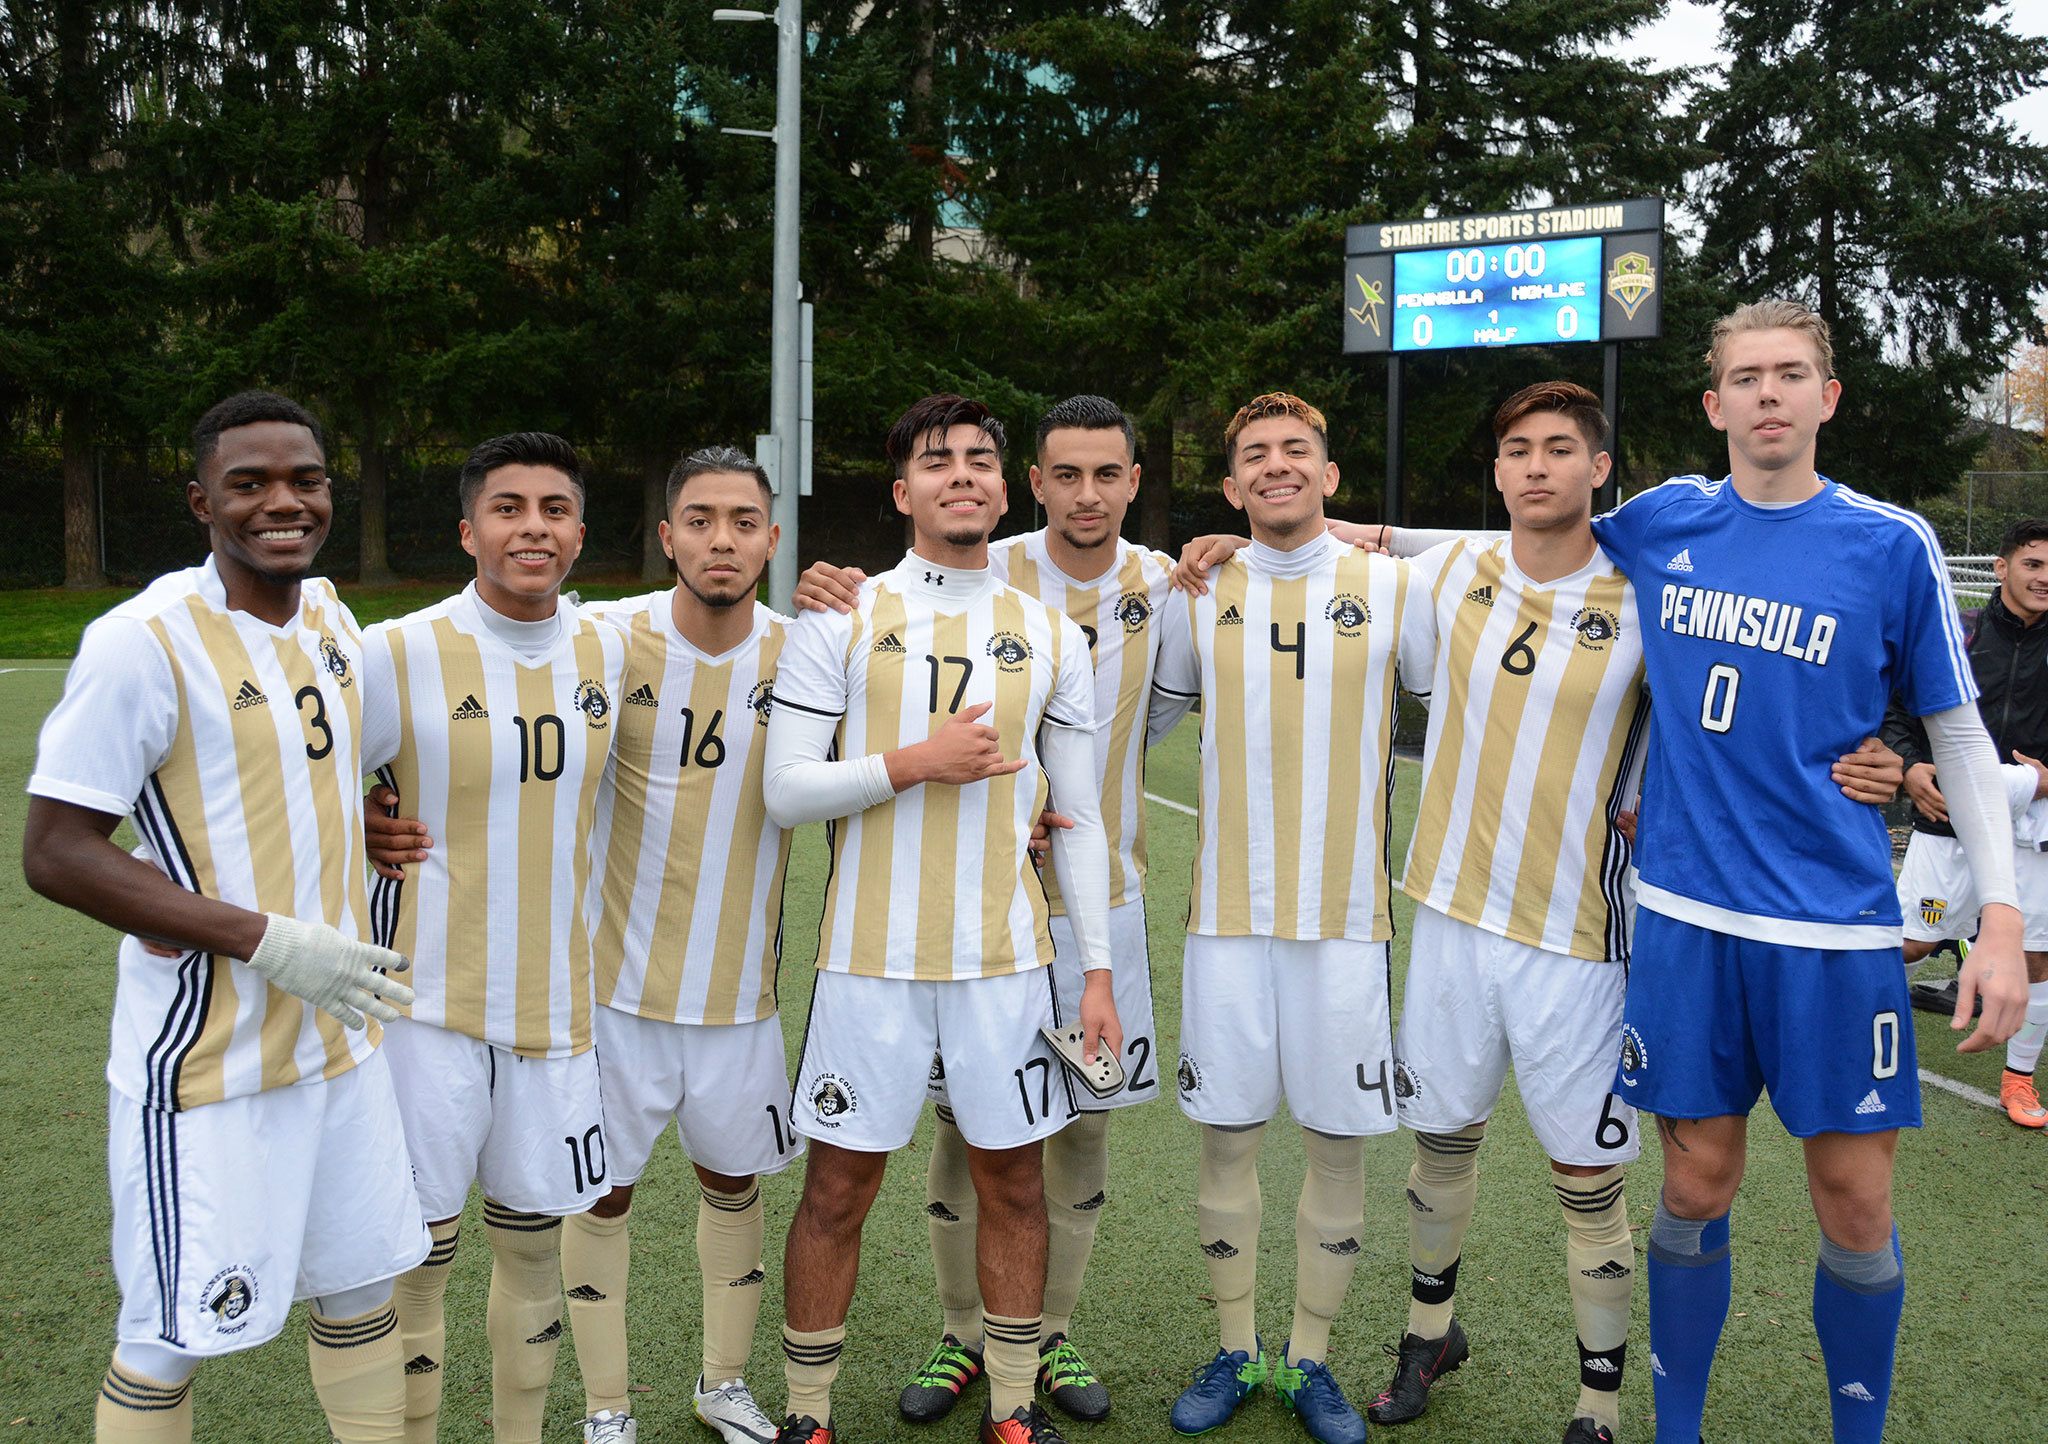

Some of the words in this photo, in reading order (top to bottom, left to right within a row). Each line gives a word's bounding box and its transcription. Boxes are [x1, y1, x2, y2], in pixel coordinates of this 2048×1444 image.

[1380, 222, 1460, 248] STARFIRE
[1463, 214, 1534, 241] SPORTS
[1538, 206, 1624, 234] STADIUM
[1446, 243, 1546, 283] 00:00
[1397, 288, 1485, 308] PENINSULA
[1512, 281, 1586, 301] HIGHLINE
[1413, 314, 1433, 347] 0
[1488, 309, 1499, 324] 1
[1556, 304, 1578, 339] 0
[1474, 326, 1518, 343] HALF
[1667, 561, 1694, 573] adidas
[1325, 593, 1351, 620] PENINSULA
[1354, 595, 1372, 624] COLLEGE
[1466, 592, 1495, 607] adidas
[1217, 616, 1244, 626] adidas
[1336, 630, 1362, 638] SOCCER
[1570, 606, 1601, 630] PENINSULA
[1605, 610, 1621, 641] COLLEGE
[1660, 583, 1838, 667] PENINSULA
[874, 644, 907, 654] adidas
[986, 631, 1010, 657] PENINSULA
[1014, 633, 1034, 660] COLLEGE
[1271, 622, 1305, 680] 4
[1501, 621, 1538, 676] 6
[1578, 639, 1604, 651] SOCCER
[999, 665, 1024, 673] SOCCER
[747, 679, 773, 709] PENINSULA
[926, 655, 973, 714] 17
[1700, 662, 1741, 736] 0
[234, 694, 269, 711] adidas
[452, 708, 489, 721] adidas
[626, 696, 659, 708] adidas
[295, 686, 333, 760] 3
[681, 708, 725, 768] 16
[513, 714, 565, 783] 10
[1872, 1009, 1899, 1080] 0
[838, 1077, 857, 1113] COLLEGE
[1014, 1057, 1049, 1125] 17
[1356, 1059, 1393, 1116] 4
[815, 1116, 842, 1128] SOCCER
[1595, 1092, 1628, 1150] 6
[1855, 1103, 1886, 1115] adidas
[565, 1123, 606, 1194] 10
[1581, 1268, 1631, 1280] adidas
[566, 1290, 607, 1302] adidas
[1583, 1361, 1619, 1374] adidas
